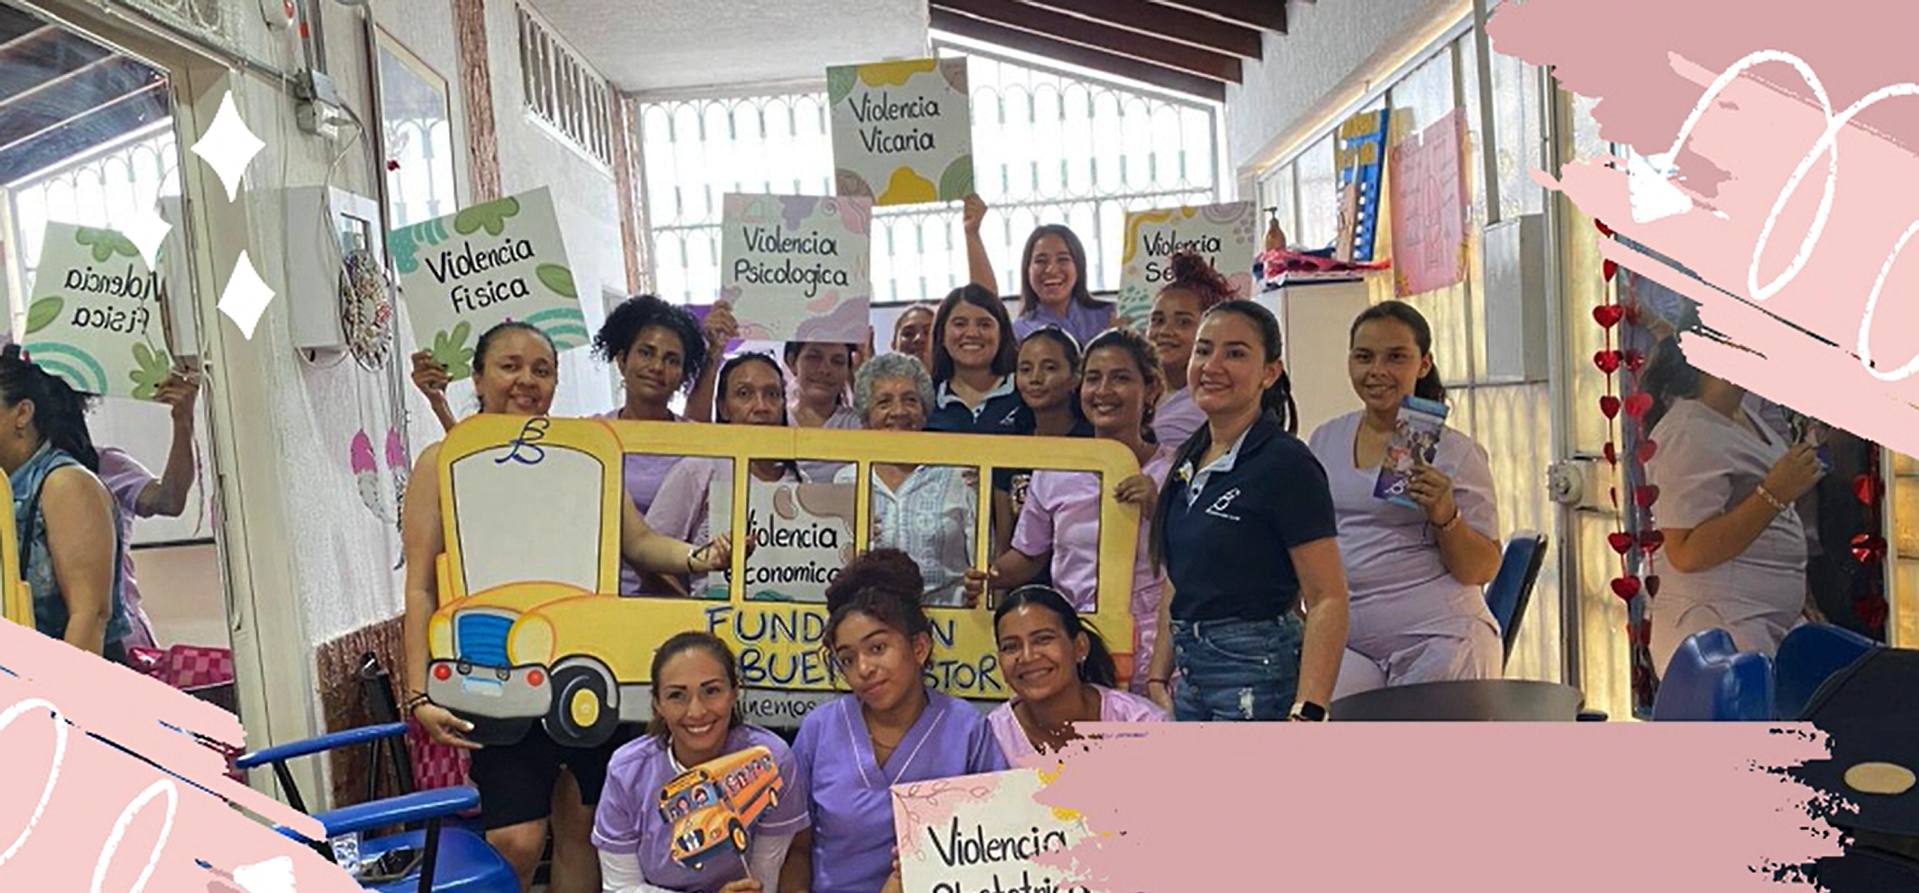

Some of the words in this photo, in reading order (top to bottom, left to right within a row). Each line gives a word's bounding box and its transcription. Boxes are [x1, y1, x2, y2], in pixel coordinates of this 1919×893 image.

[848, 90, 940, 122] Violencia
[859, 126, 936, 153] Vicaria
[743, 224, 838, 256] Violencia
[425, 238, 535, 284] Violencia
[734, 257, 849, 298] Psicologica
[927, 816, 1068, 867] Violencia
